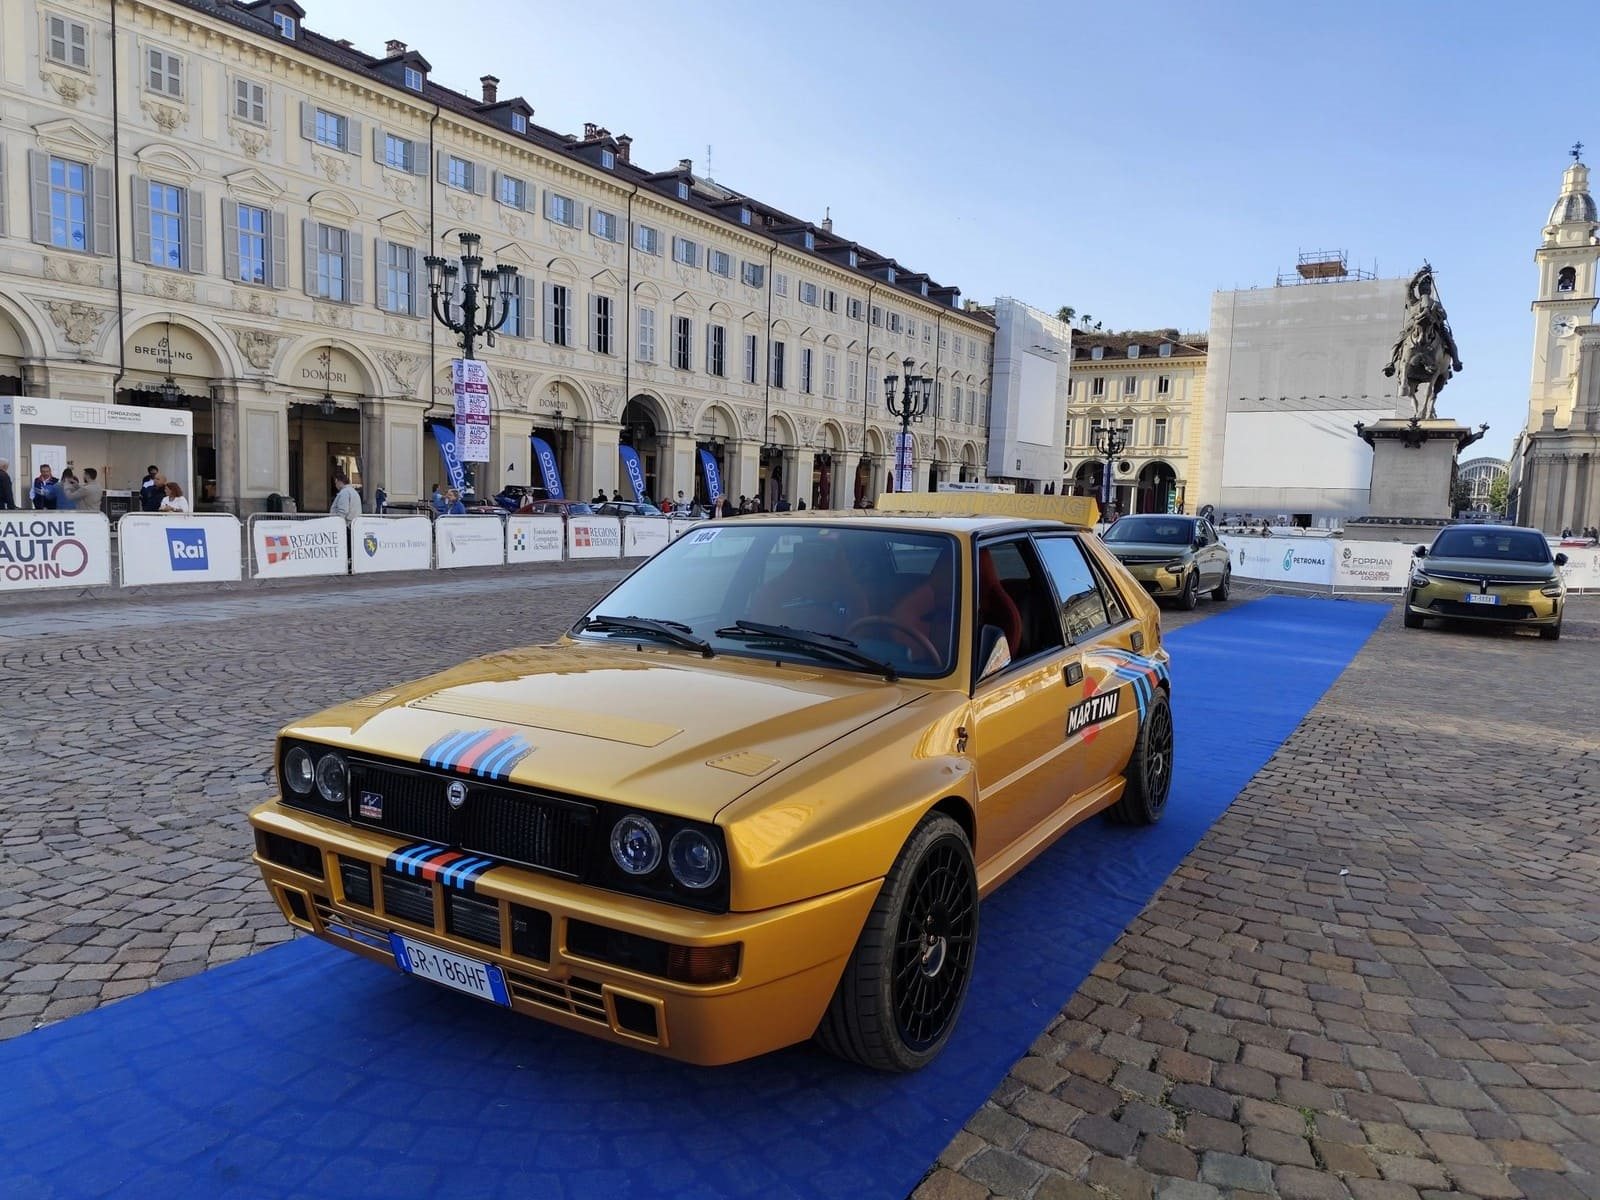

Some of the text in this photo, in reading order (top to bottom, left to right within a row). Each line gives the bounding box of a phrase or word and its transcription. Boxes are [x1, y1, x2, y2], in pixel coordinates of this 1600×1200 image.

[134, 345, 194, 361] BREITLING
[302, 368, 347, 384] DOMORI
[171, 538, 205, 559] Rai
[1293, 557, 1325, 566] PETRONAS
[1352, 557, 1393, 566] FOPPIANI
[1067, 692, 1118, 735] MARTINI
